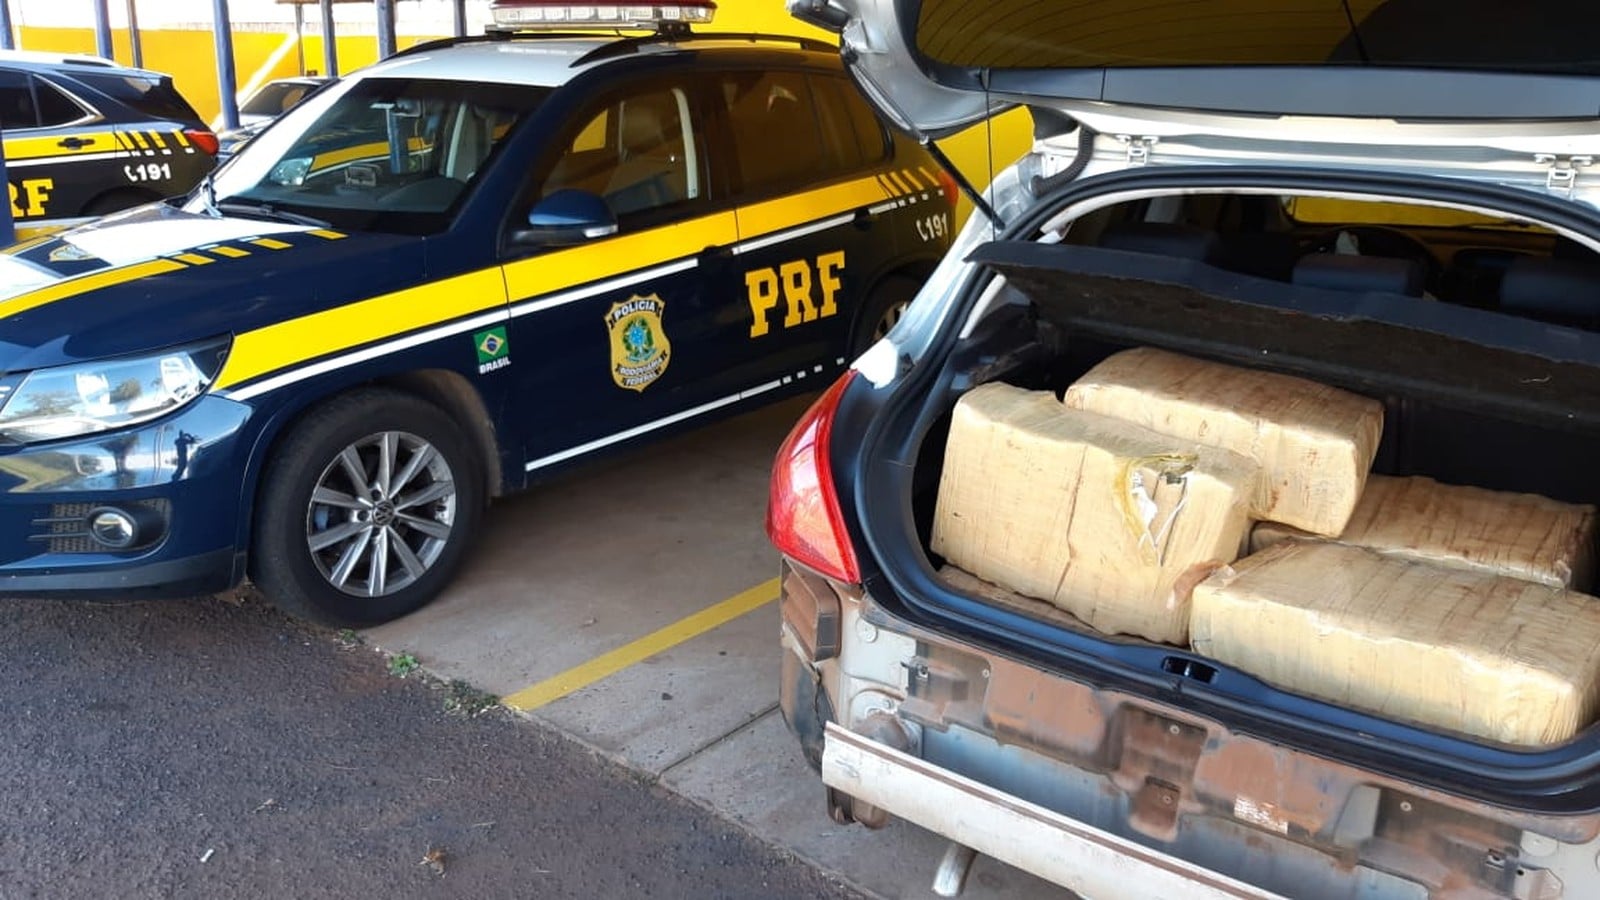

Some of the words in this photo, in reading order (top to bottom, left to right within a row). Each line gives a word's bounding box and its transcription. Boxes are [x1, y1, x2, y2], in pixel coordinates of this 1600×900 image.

[135, 162, 172, 181] 191
[925, 212, 948, 239] 191
[745, 250, 846, 338] PRF
[479, 355, 512, 374] BRASIL
